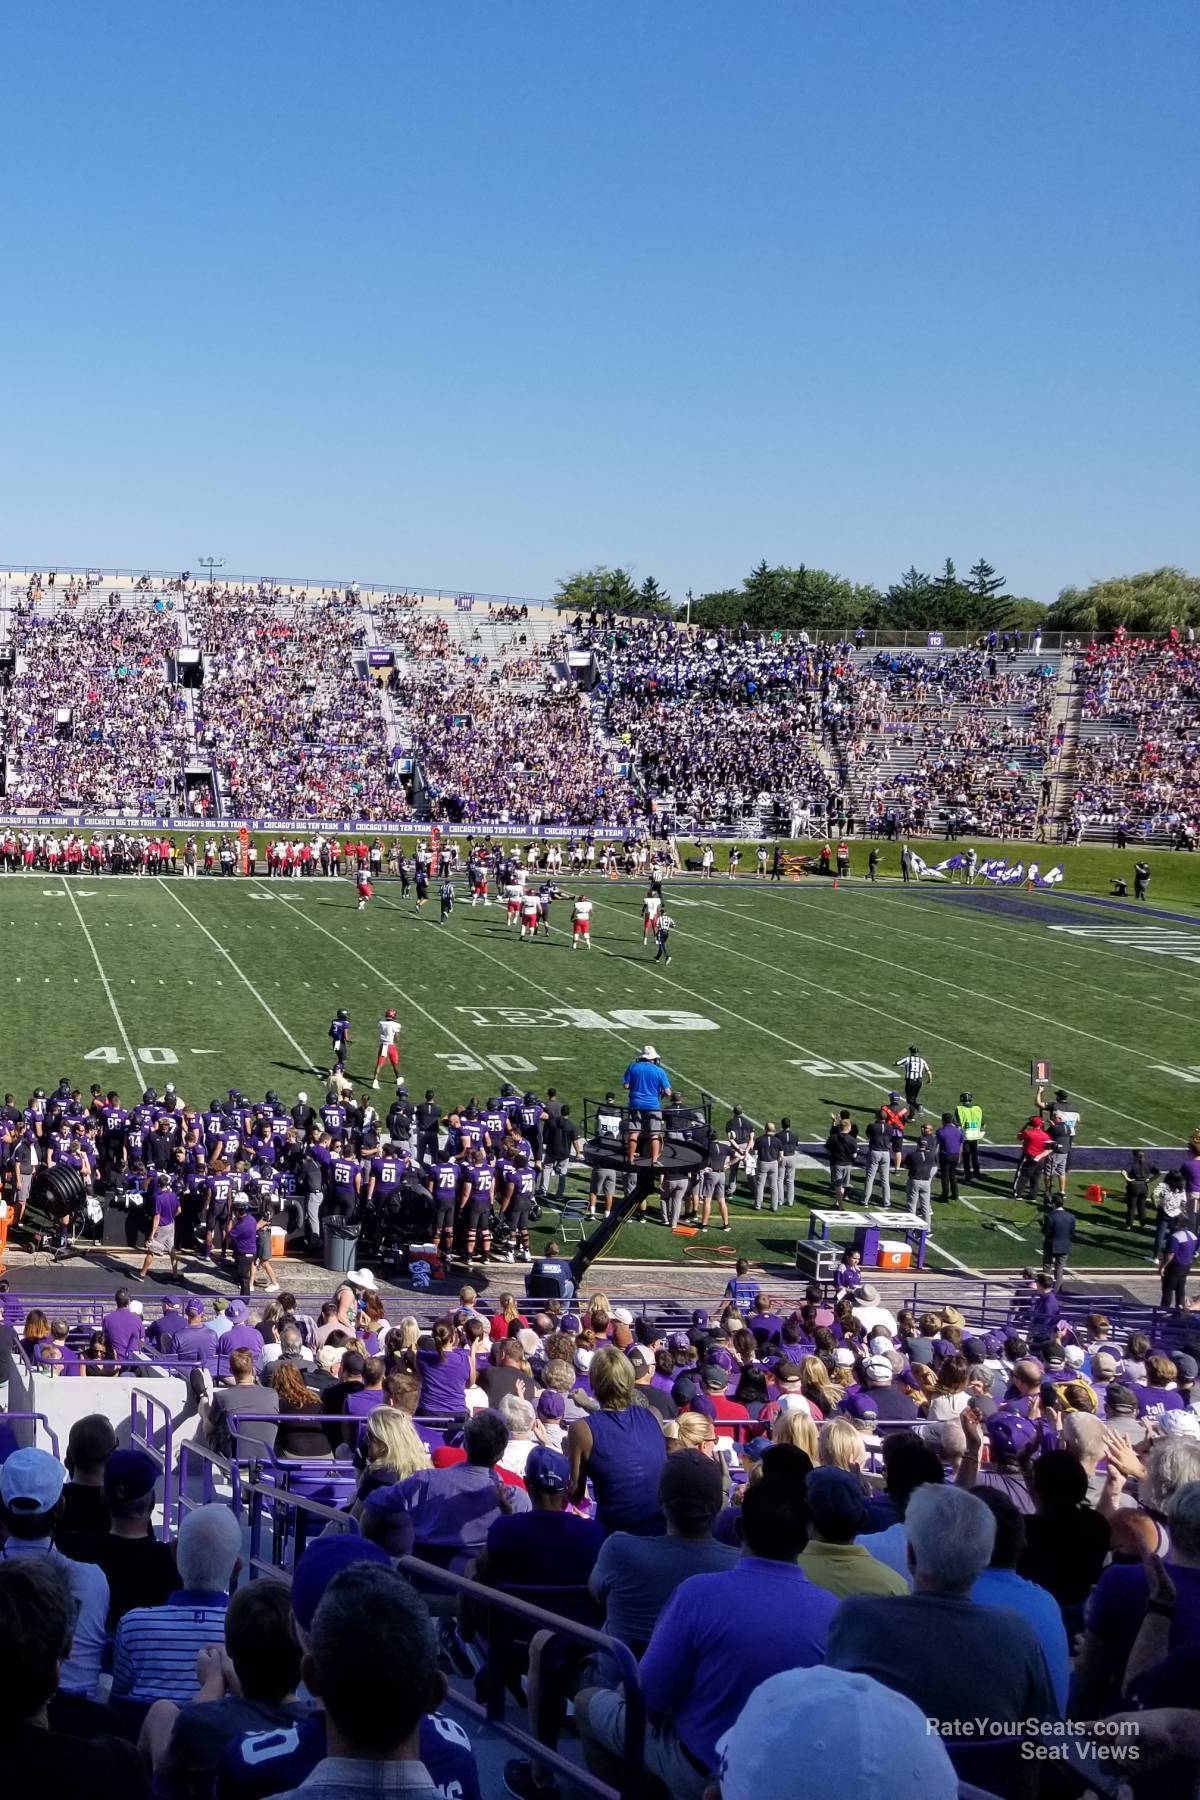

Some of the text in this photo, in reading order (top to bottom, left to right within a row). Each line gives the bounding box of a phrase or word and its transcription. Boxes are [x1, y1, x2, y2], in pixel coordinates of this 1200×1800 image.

[930, 637, 941, 646] 113
[84, 818, 114, 826] CHICAGO'S
[116, 818, 126, 826] BIG
[128, 818, 138, 826] TEN
[140, 818, 156, 826] TEAM
[174, 820, 205, 828] CHICAGO'S
[206, 820, 216, 828] BIG
[217, 820, 229, 828] TEN
[264, 822, 295, 830] CHICAGO'S
[296, 822, 307, 830] BIG
[308, 822, 320, 830] TEN
[321, 822, 338, 830] TEAM
[356, 824, 387, 832] CHICAGO'S
[388, 824, 399, 832] BIG
[400, 824, 412, 832] TEN
[414, 824, 432, 832] TEAM
[449, 826, 481, 834] CHICAGO'S
[482, 826, 493, 834] BIG
[494, 826, 508, 834] TEN
[509, 826, 526, 834] TEAM
[83, 1046, 180, 1065] 40
[435, 1053, 538, 1072] 30
[785, 1059, 903, 1078] 20
[1037, 1062, 1045, 1079] 1
[208, 1121, 221, 1134] 41
[325, 1115, 340, 1127] 40
[487, 1119, 502, 1132] 93
[225, 1140, 239, 1153] 82
[334, 1168, 350, 1183] 63
[381, 1168, 396, 1183] 61
[439, 1173, 455, 1188] 79
[478, 1175, 492, 1191] 75
[215, 1185, 228, 1200] 12
[892, 1253, 902, 1264] G
